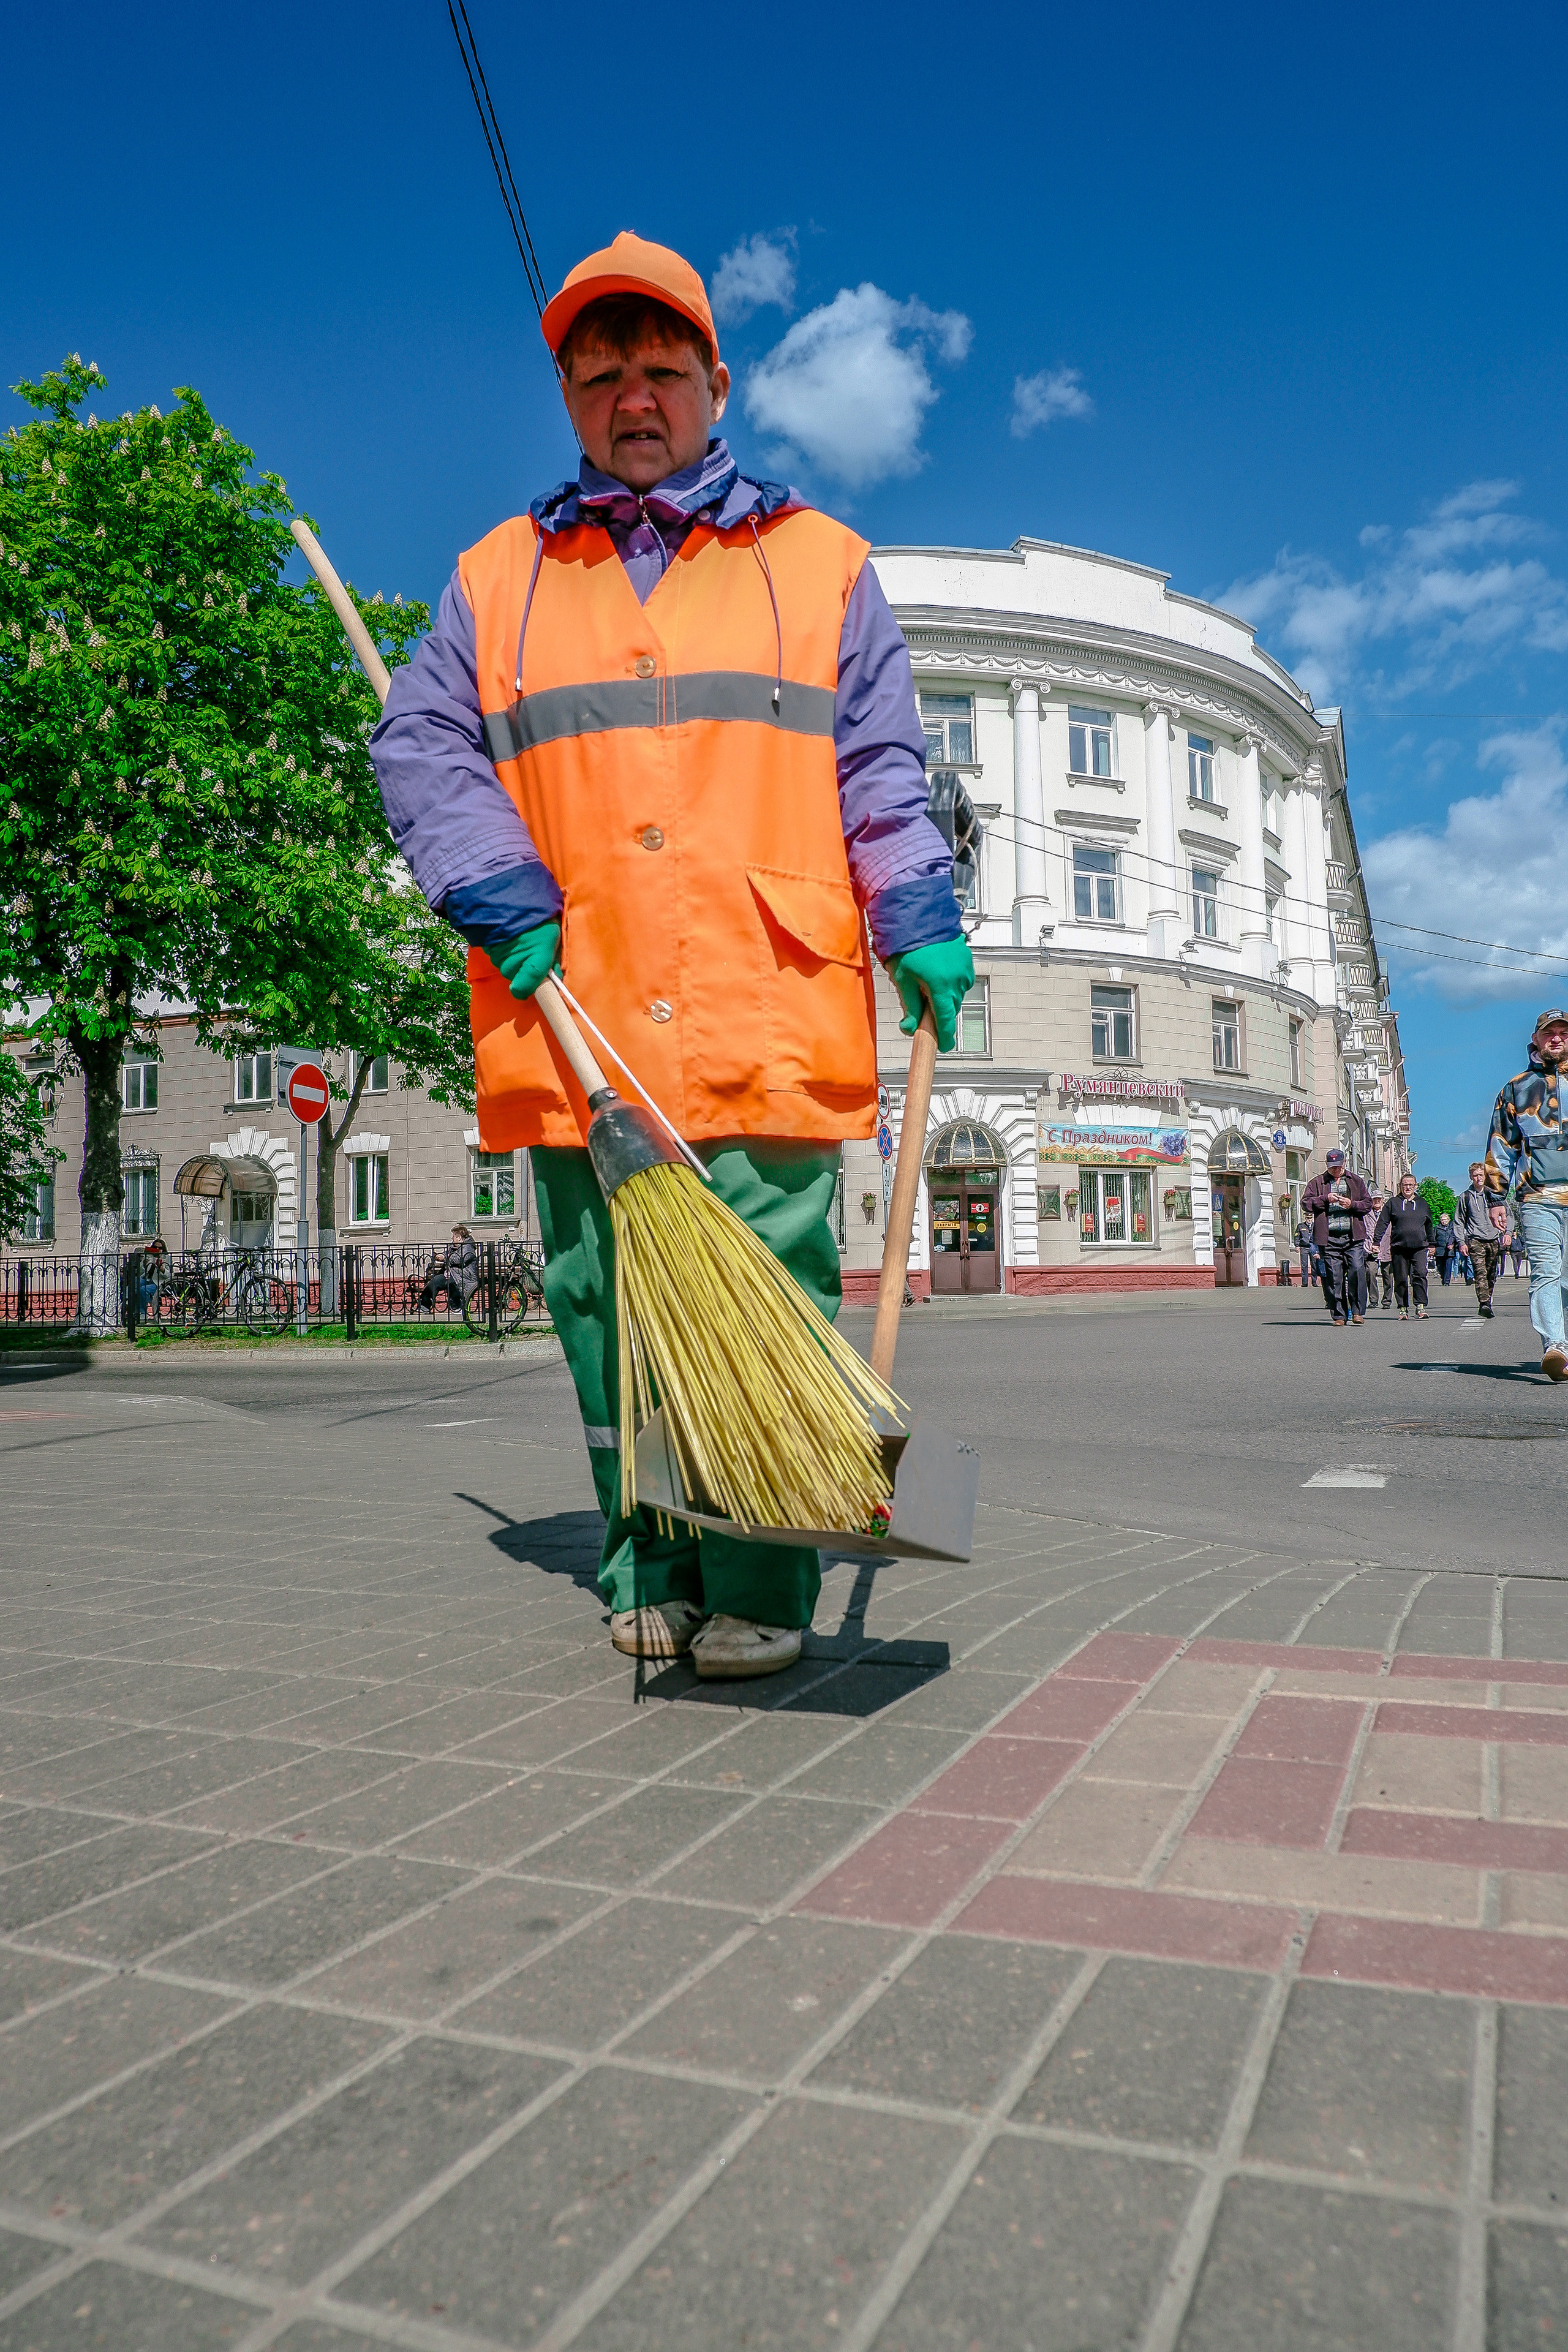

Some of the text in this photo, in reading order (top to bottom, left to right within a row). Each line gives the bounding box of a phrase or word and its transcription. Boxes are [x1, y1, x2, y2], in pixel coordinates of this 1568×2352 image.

[1061, 1073, 1185, 1099] Румянцевский
[1048, 1129, 1152, 1146] С Праздником!
